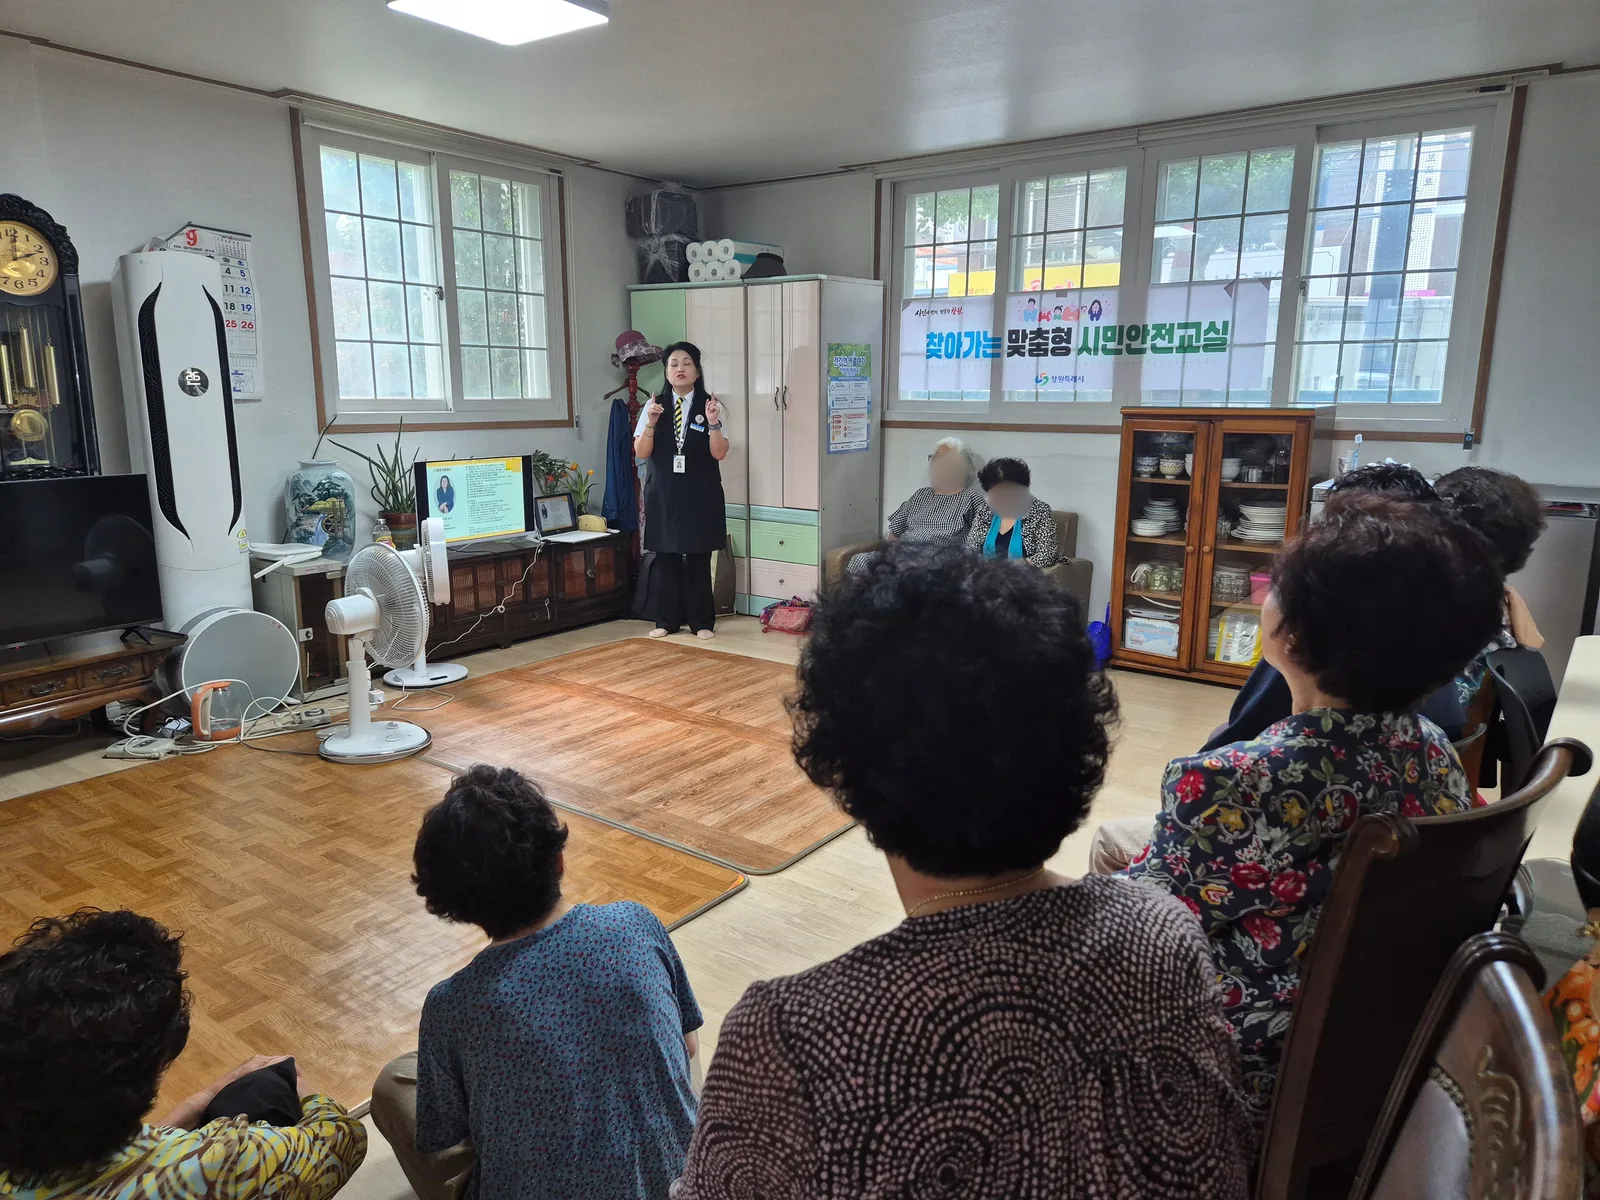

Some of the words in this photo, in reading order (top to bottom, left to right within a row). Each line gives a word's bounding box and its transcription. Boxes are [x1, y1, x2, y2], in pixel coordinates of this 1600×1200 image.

[185, 229, 198, 247] 9
[40, 257, 49, 266] 3
[36, 269, 45, 278] 4
[225, 267, 231, 275] 4
[240, 269, 246, 277] 5
[0, 276, 10, 285] 7
[14, 279, 24, 289] 6
[28, 278, 38, 287] 5
[224, 284, 234, 293] 11
[240, 286, 251, 295] 12
[224, 302, 235, 311] 18
[241, 303, 252, 312] 19
[225, 319, 237, 328] 25
[241, 321, 254, 329] 26
[925, 331, 1001, 360] 찾아가는
[1006, 326, 1072, 358] 맞춤형
[1077, 320, 1230, 357] 시민안전교실
[1050, 375, 1085, 384] 창원특례시
